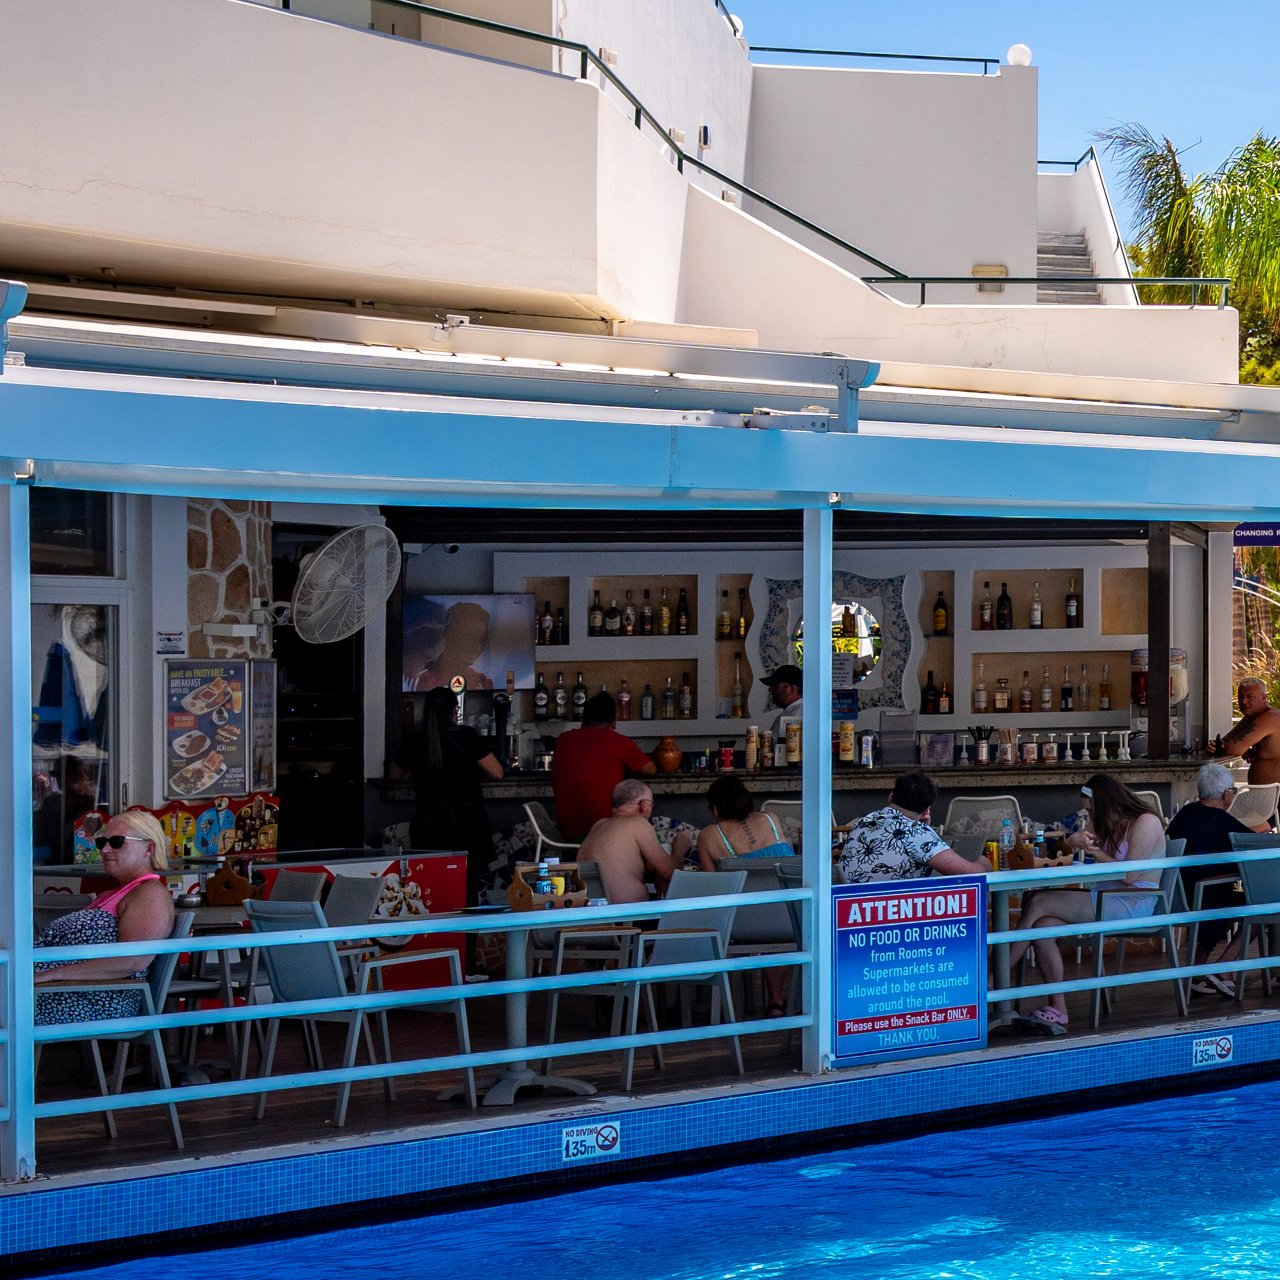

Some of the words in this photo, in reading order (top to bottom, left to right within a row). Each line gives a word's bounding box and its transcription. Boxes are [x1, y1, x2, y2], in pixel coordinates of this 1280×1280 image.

[170, 679, 201, 687] BREAKFAST
[848, 894, 967, 924] ATTENTION!
[849, 932, 866, 948] NO
[870, 928, 901, 946] FOOD
[904, 928, 920, 942] OR
[924, 923, 967, 940] DRINKS
[871, 950, 895, 963] from
[899, 946, 933, 961] Rooms
[936, 946, 946, 956] or
[863, 962, 935, 982] Supermarkets
[938, 960, 954, 972] are
[847, 982, 888, 998] allowed
[891, 980, 901, 993] to
[903, 977, 915, 992] be
[919, 973, 969, 991] consumed
[867, 996, 903, 1013] around
[906, 994, 922, 1008] the
[925, 992, 949, 1009] pool.
[845, 1020, 872, 1032] Please
[874, 1019, 889, 1028] use
[891, 1016, 903, 1027] the
[906, 1012, 930, 1025] Snack
[931, 1011, 945, 1022] Bar
[947, 1008, 970, 1020] ONLY.
[878, 1030, 913, 1047] THANK
[916, 1028, 940, 1042] YOU.
[1203, 1039, 1217, 1047] DIVING
[565, 1129, 574, 1138] NO
[576, 1127, 598, 1136] DIVING
